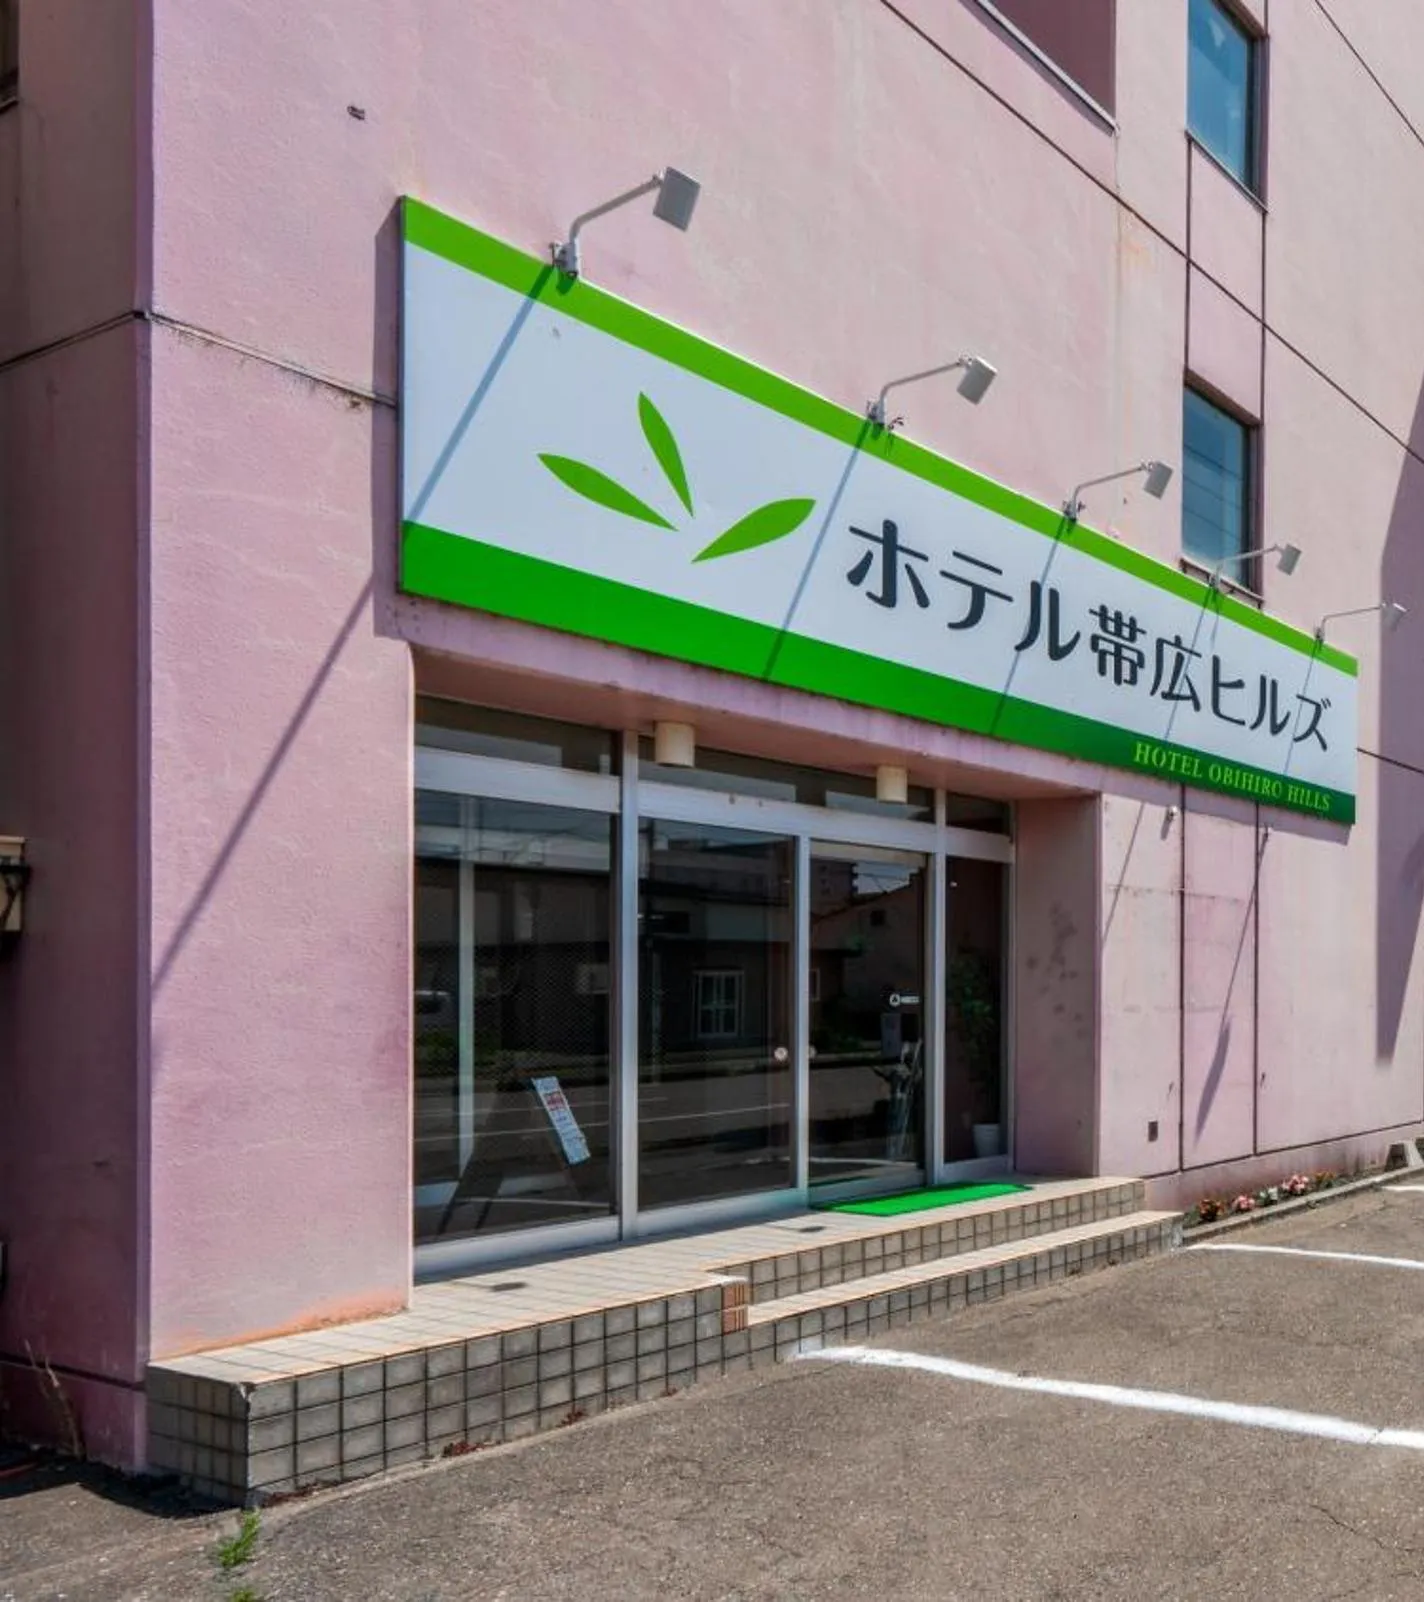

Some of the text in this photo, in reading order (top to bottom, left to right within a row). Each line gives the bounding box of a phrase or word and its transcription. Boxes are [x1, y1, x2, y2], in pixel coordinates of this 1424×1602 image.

[846, 519, 1332, 752] ホテル帯広ヒルズ
[1133, 742, 1331, 812] HOTEL OBIHIRO HILLS
